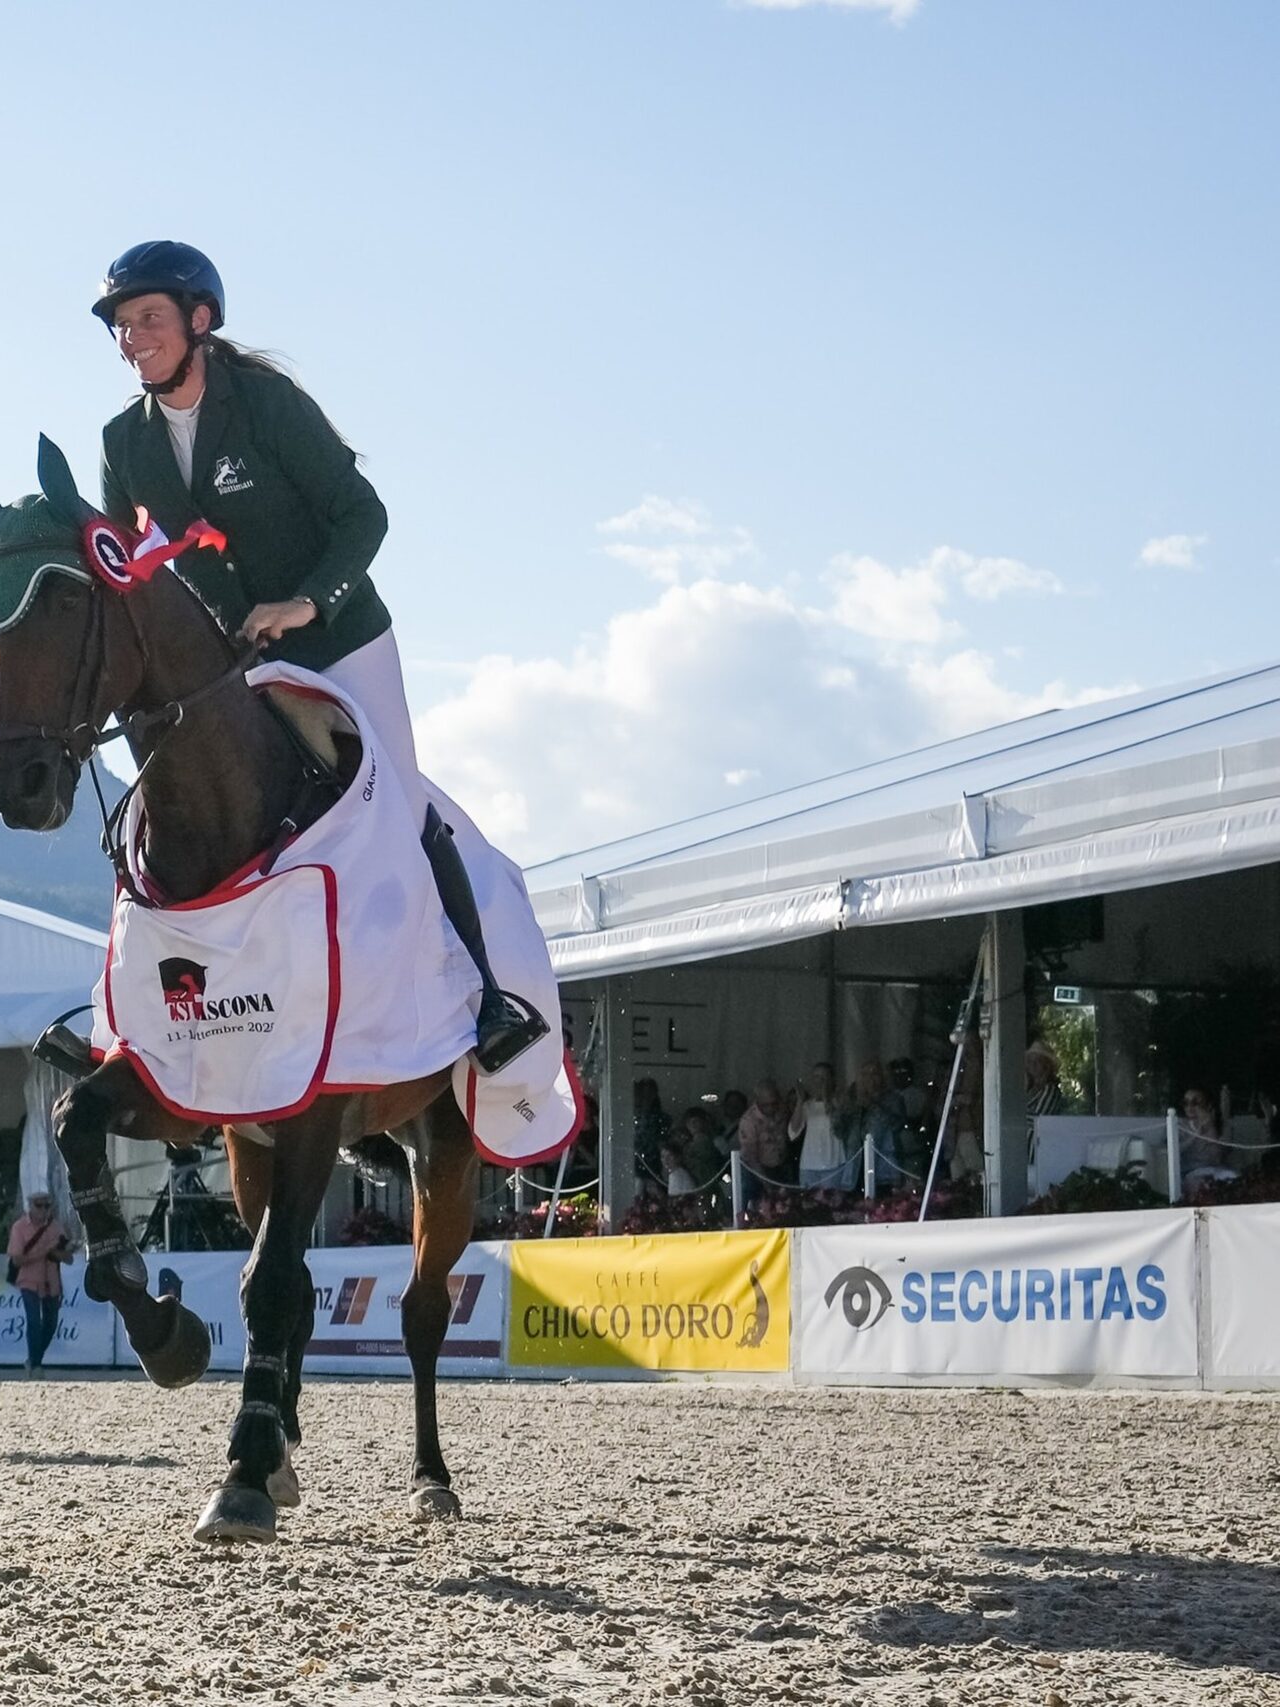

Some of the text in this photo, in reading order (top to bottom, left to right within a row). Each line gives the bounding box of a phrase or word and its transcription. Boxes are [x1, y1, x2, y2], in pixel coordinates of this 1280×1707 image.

[901, 1263, 1167, 1323] SECURITAS
[523, 1303, 734, 1340] CHICCO D'ORO
